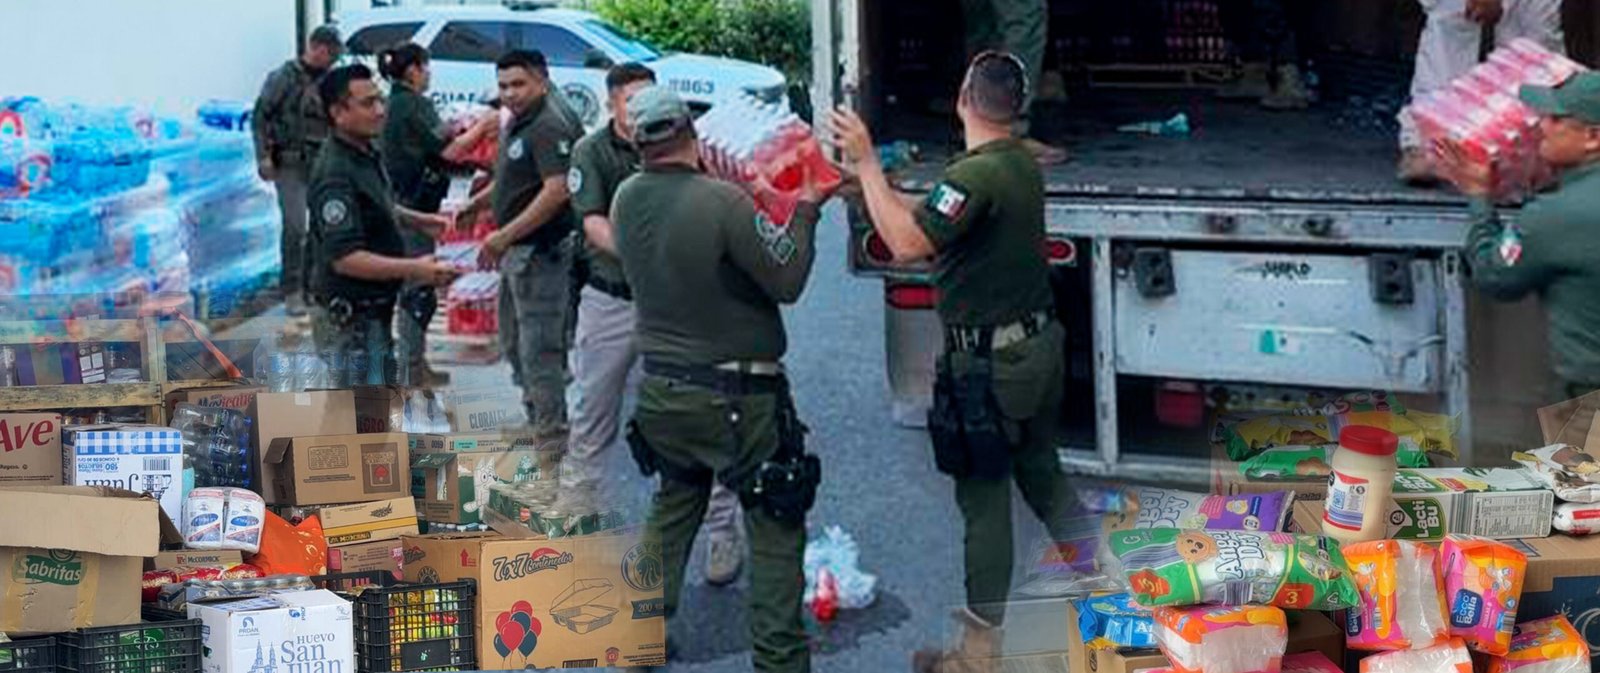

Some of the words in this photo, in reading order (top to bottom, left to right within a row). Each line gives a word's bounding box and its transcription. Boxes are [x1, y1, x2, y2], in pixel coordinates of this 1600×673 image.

[1412, 500, 1430, 538] Lacti
[1427, 506, 1440, 528] Bu
[18, 557, 81, 581] Sabritas
[493, 553, 530, 581] 7x7
[1286, 591, 1298, 604] 3
[1464, 596, 1477, 624] Bella
[281, 640, 326, 664] San
